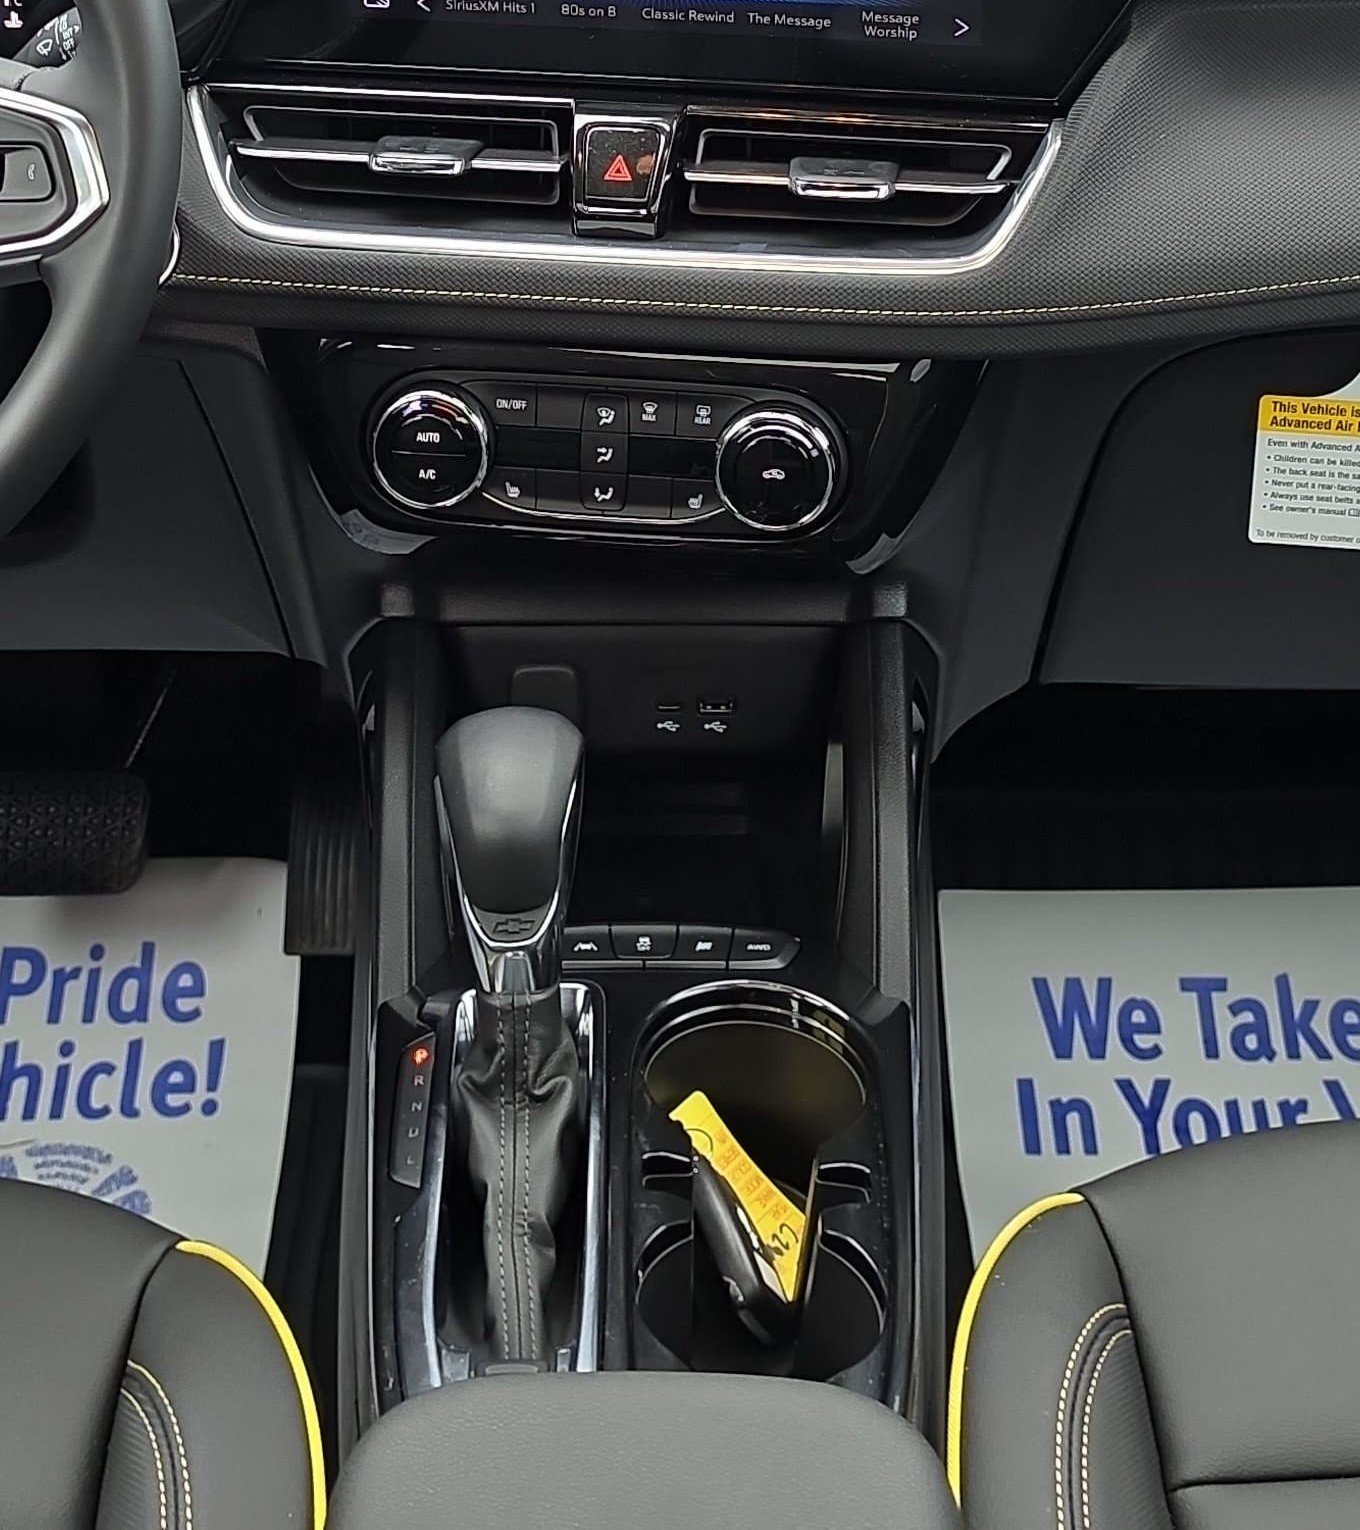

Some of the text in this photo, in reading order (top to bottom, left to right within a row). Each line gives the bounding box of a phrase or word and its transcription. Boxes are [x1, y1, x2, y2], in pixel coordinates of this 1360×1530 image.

[503, 0, 527, 14] Hits
[530, 2, 536, 14] 1
[561, 4, 617, 17] 80s on 8
[641, 7, 735, 24] Classic Rewind
[747, 12, 832, 30] The Message
[861, 11, 920, 26] Message
[863, 25, 918, 41] Worship
[496, 399, 528, 411] ON/OFF
[1272, 401, 1297, 414] This
[1302, 402, 1347, 417] Vehicle
[1351, 405, 1360, 418] is
[694, 416, 711, 425] REAR
[1270, 415, 1331, 430] Advanced
[1335, 420, 1354, 432] Air
[416, 432, 440, 443] AUTO
[1267, 438, 1287, 447] Even
[1290, 439, 1308, 448] with
[1310, 442, 1352, 452] Advanced
[1274, 454, 1307, 464] Children
[1310, 456, 1324, 464] can
[1327, 457, 1337, 466] be
[418, 469, 436, 480] A/C
[1273, 466, 1286, 475] The
[1289, 467, 1306, 476] back
[1309, 469, 1326, 477] seat
[1328, 470, 1335, 478] is
[1337, 471, 1350, 479] the
[1271, 480, 1293, 488] Never
[1295, 480, 1309, 489] put
[1317, 481, 1360, 493] rear-facing
[1270, 491, 1298, 501] Always
[1316, 494, 1333, 503] seat
[1334, 496, 1353, 505] belts
[1256, 529, 1264, 537] To
[1266, 530, 1275, 538] be
[1277, 531, 1308, 540] removed
[1310, 533, 1319, 542] by
[1320, 534, 1354, 543] customer
[746, 943, 772, 952] AWD
[1032, 975, 1163, 1061] We
[414, 1048, 428, 1065] P
[414, 1075, 424, 1086] R
[411, 1102, 422, 1112] N
[1015, 1077, 1099, 1157] In
[408, 1127, 419, 1139] D
[407, 1156, 415, 1165] L
